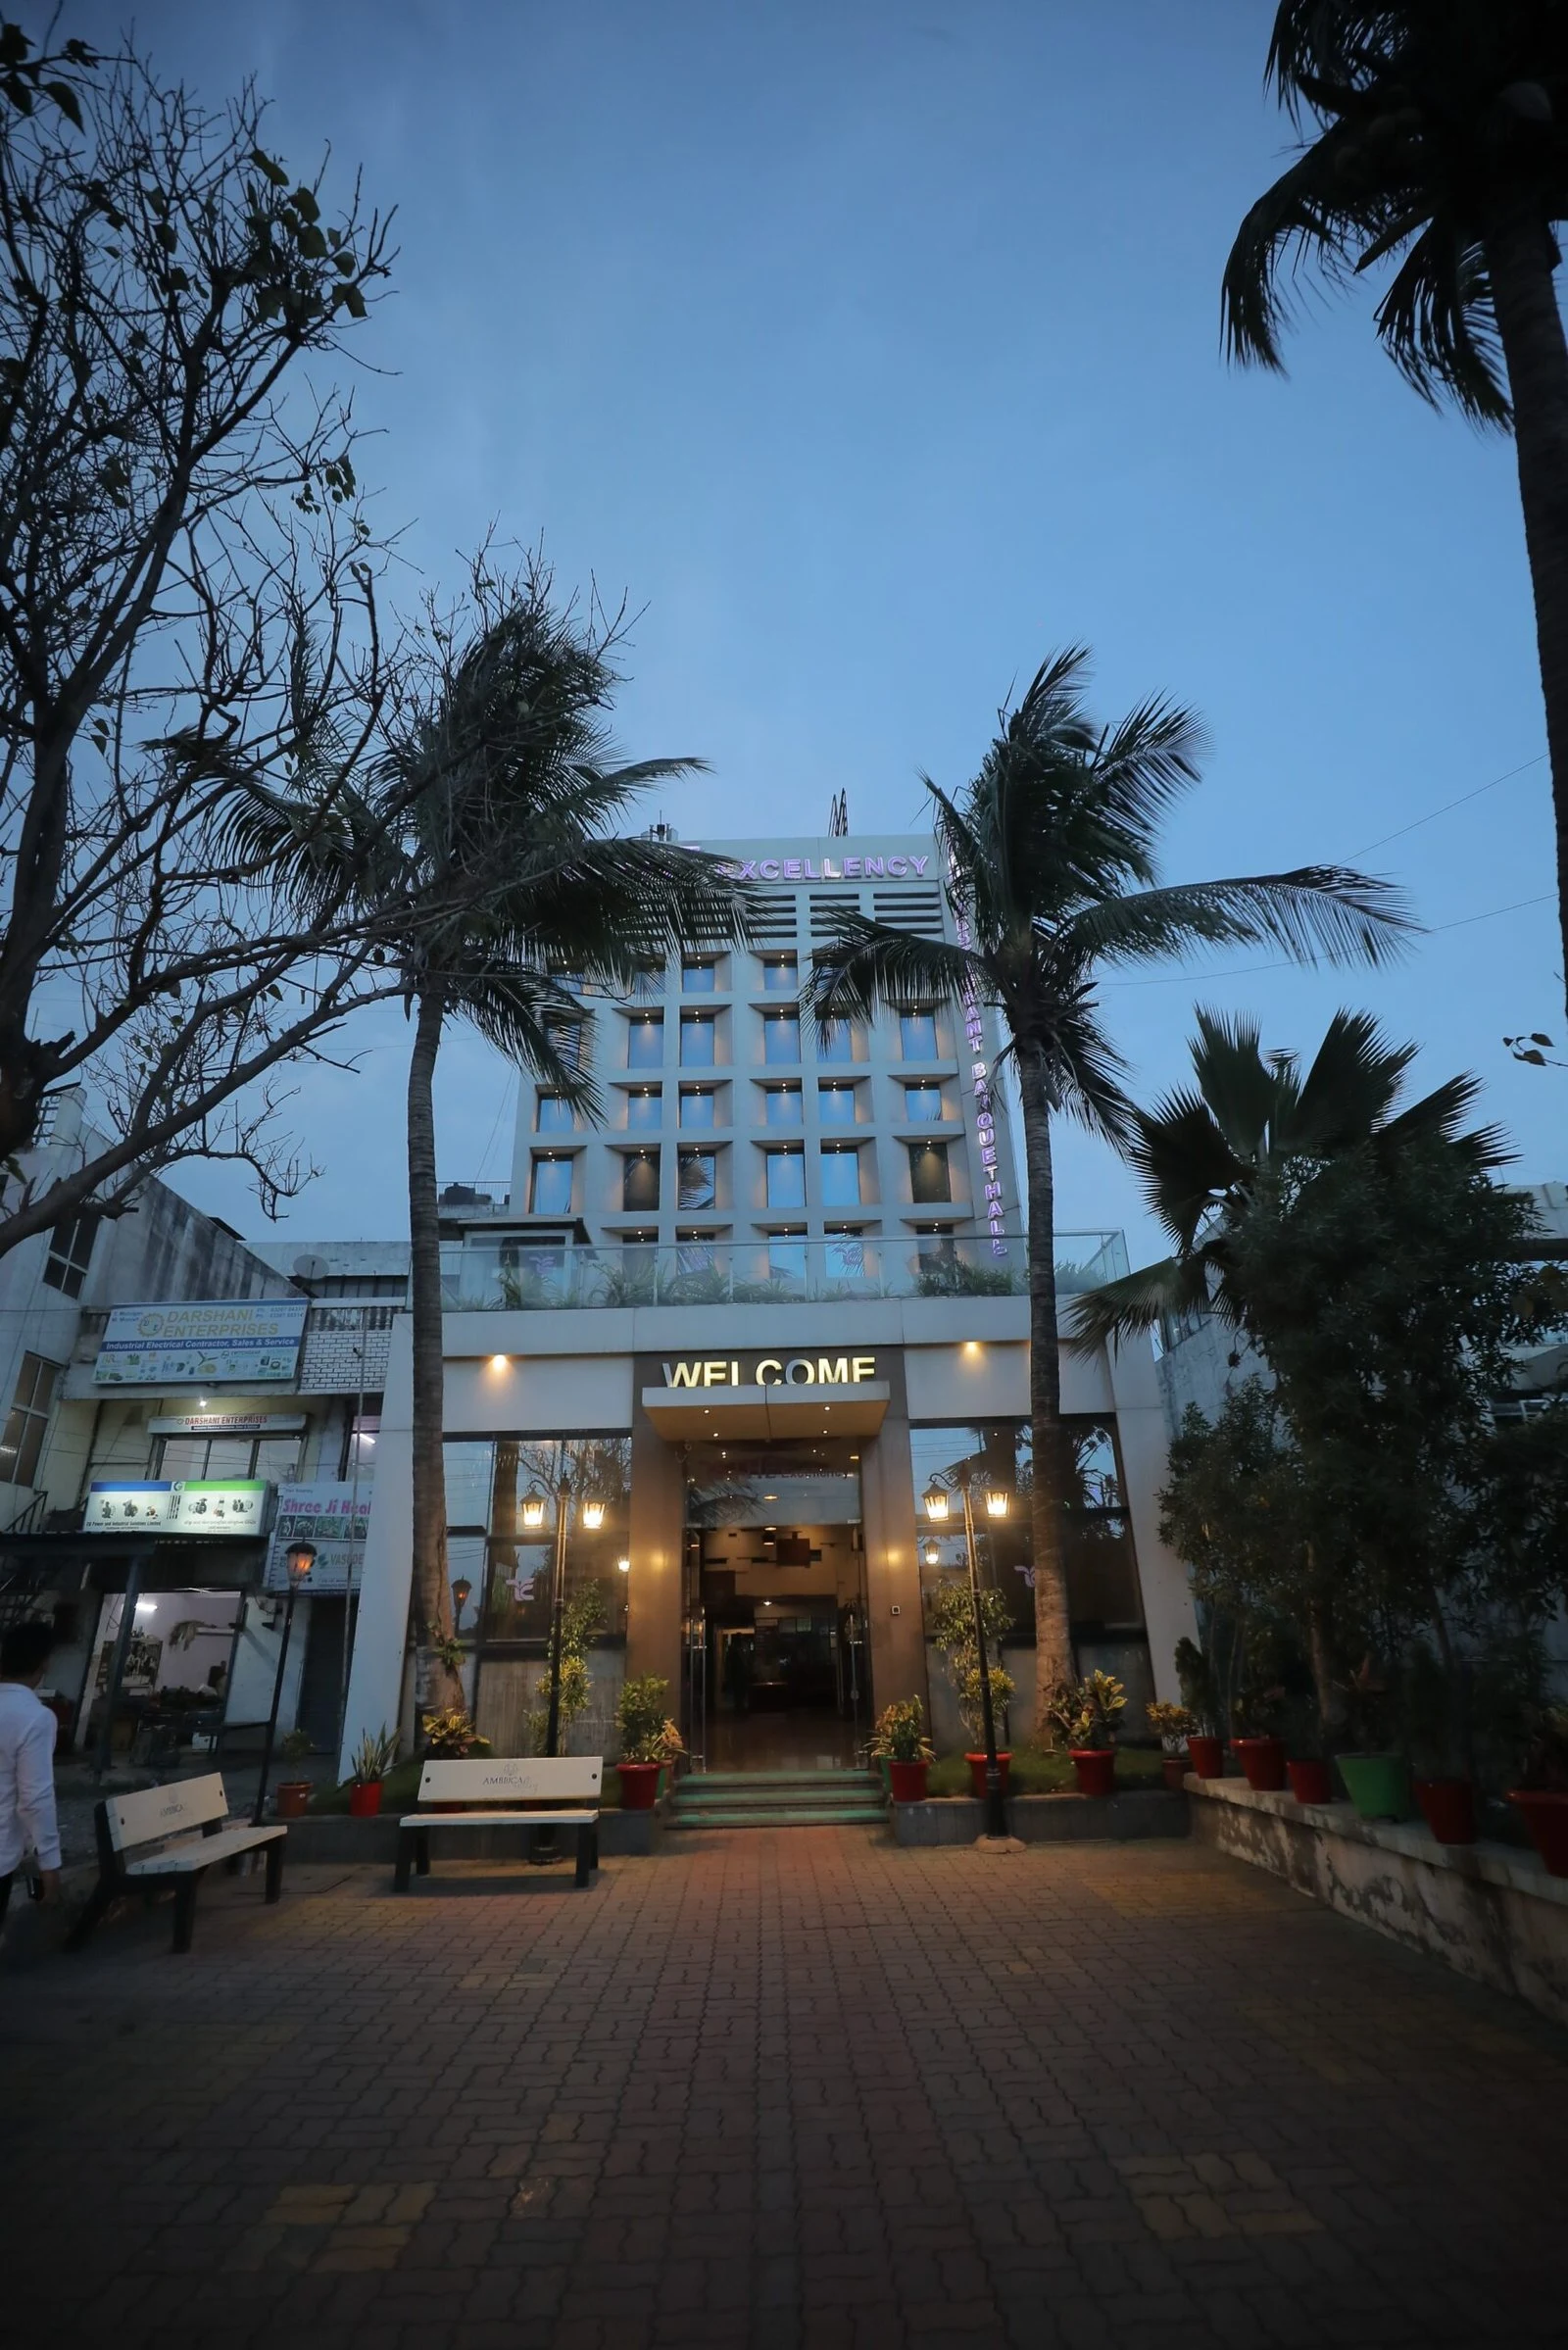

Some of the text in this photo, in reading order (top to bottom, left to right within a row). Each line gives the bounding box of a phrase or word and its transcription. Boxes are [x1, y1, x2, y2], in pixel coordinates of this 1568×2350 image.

[168, 1308, 253, 1323] DARSHANI
[163, 1323, 278, 1338] ENTERPRISES
[106, 1342, 144, 1350] Industrial
[146, 1340, 184, 1349] Electrical
[185, 1339, 229, 1349] Contractor,
[231, 1339, 255, 1347] Sales
[184, 1415, 268, 1425] DARSHANI ENTERPRISES
[283, 1497, 321, 1513] Shree
[325, 1498, 338, 1514] Ji
